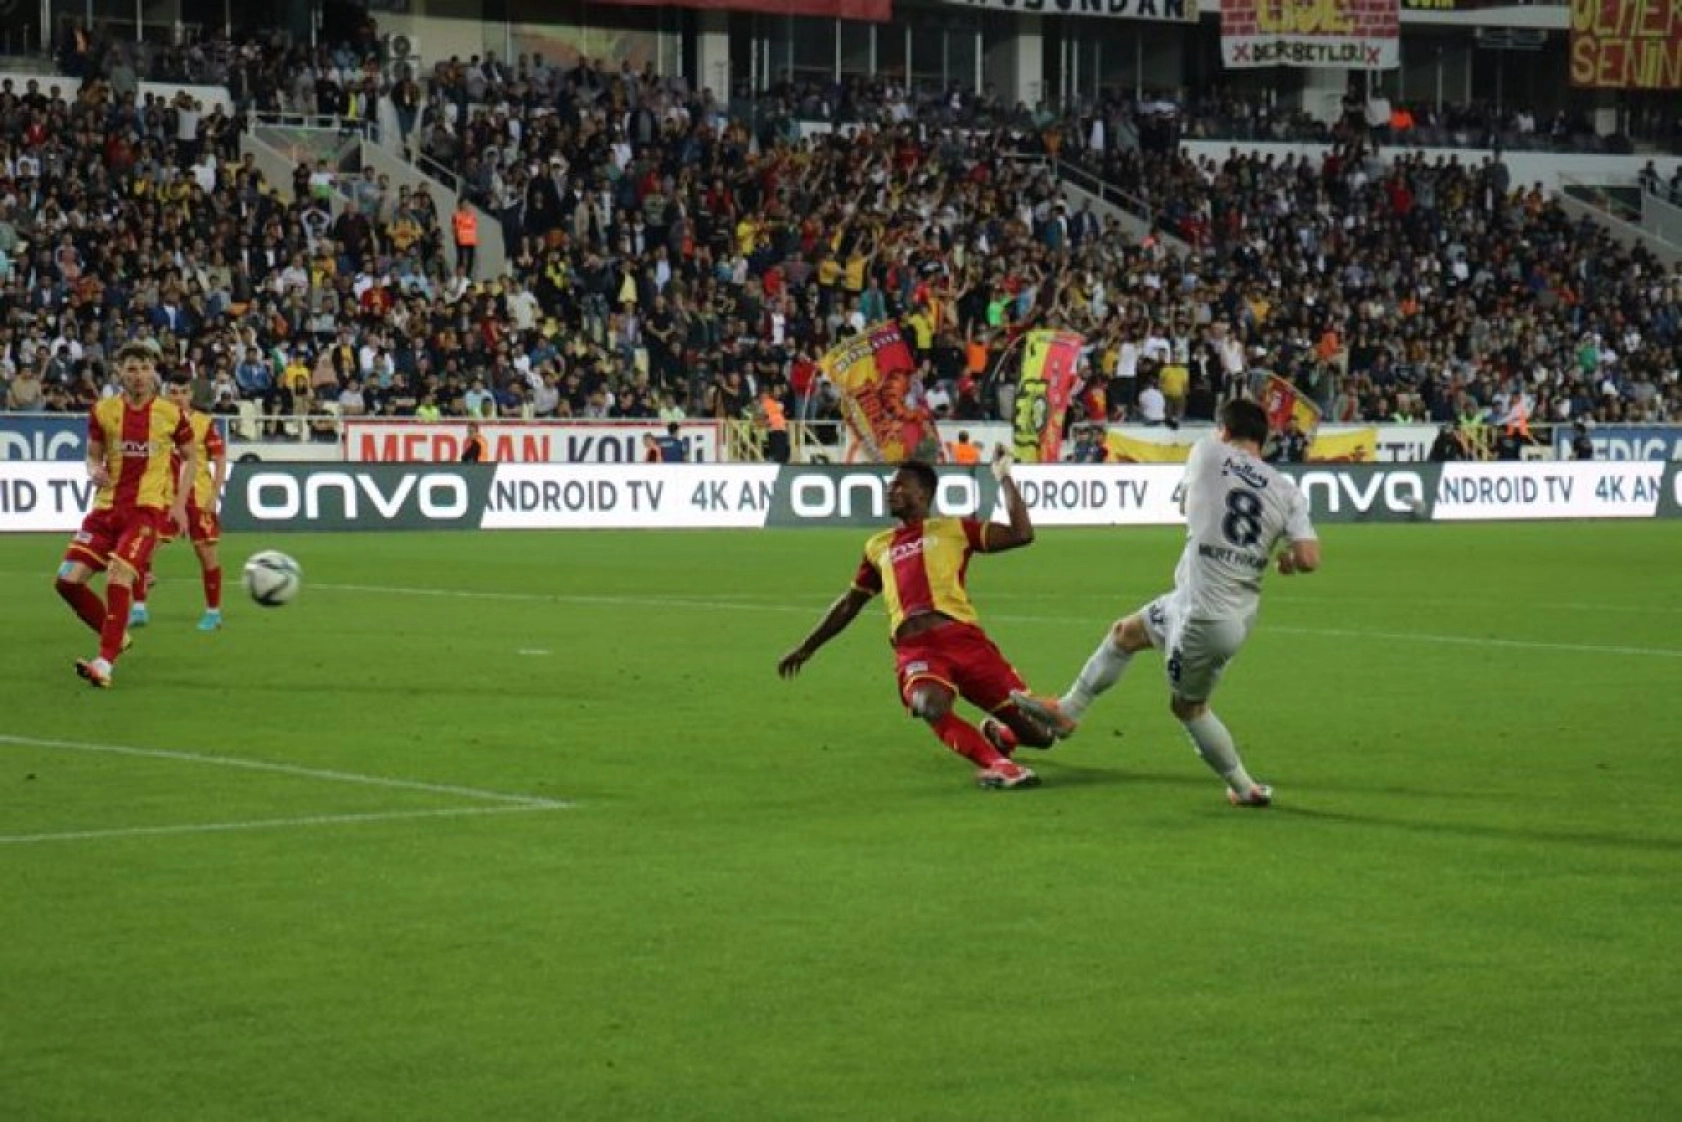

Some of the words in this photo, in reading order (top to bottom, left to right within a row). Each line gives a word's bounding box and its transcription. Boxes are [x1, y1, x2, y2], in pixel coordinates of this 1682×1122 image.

[361, 434, 550, 461] MEAN
[47, 479, 94, 513] TV
[626, 480, 664, 512] TV
[691, 480, 728, 512] 4K
[790, 474, 980, 517] ono
[998, 480, 1107, 508] DROID
[1115, 480, 1147, 507] TV
[1284, 471, 1424, 513] nvo
[1544, 476, 1574, 504] TV
[1595, 476, 1626, 502] 4K
[1222, 487, 1263, 547] 8
